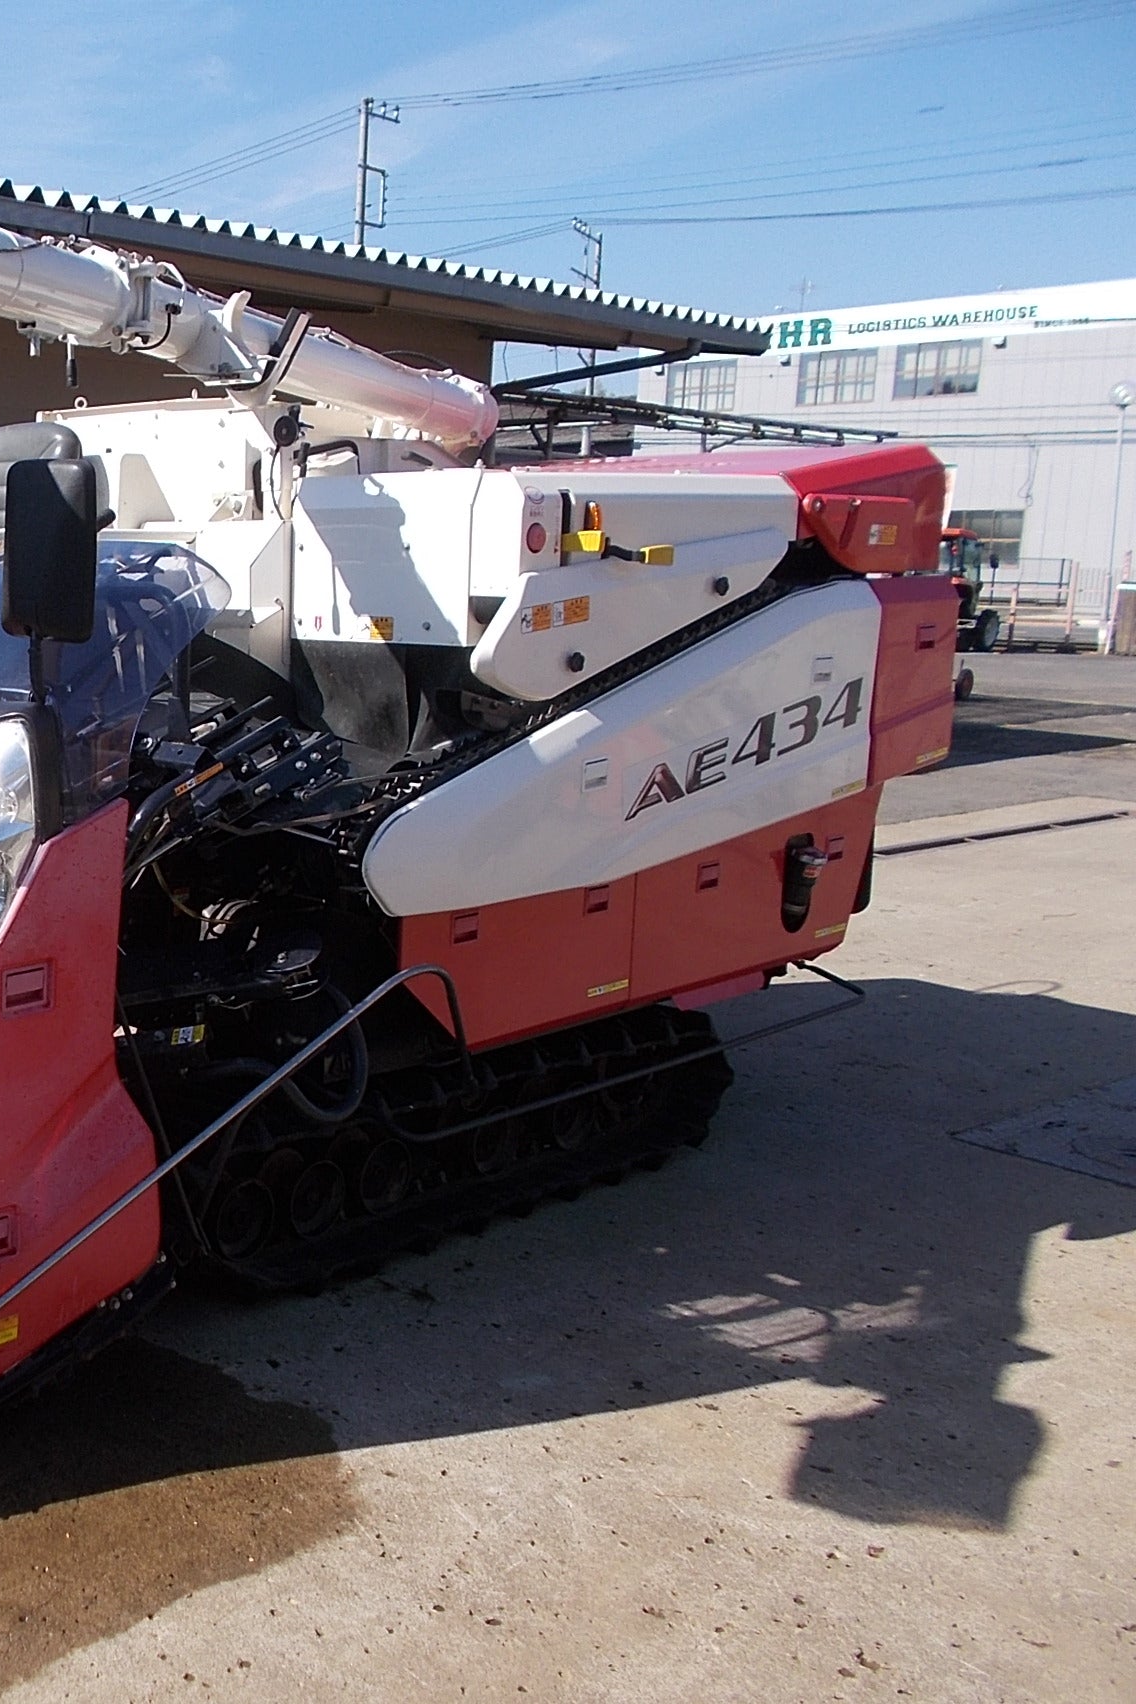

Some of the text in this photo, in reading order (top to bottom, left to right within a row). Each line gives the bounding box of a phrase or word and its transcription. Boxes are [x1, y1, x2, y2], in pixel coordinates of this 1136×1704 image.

[847, 316, 927, 335] LOGISTICS
[932, 305, 1039, 328] WAREHOUSE
[624, 676, 864, 822] AE434
